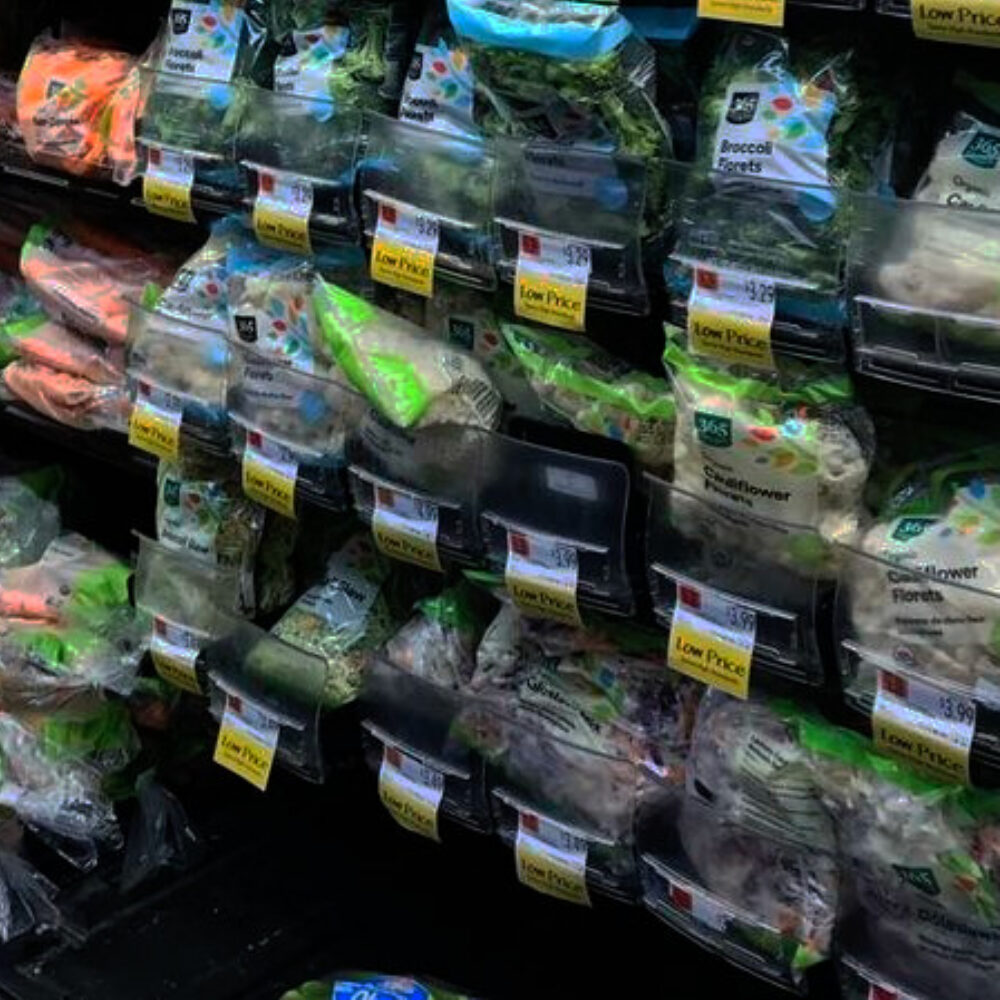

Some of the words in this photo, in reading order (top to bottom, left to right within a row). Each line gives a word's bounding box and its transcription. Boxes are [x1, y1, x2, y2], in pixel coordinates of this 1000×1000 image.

[919, 5, 954, 20] Low
[957, 6, 1000, 26] Price
[720, 139, 774, 155] Broccoli
[718, 156, 763, 174] Florets
[376, 251, 398, 266] Low
[400, 255, 429, 275] Price
[520, 286, 545, 302] Low
[547, 290, 581, 311] Price
[693, 321, 724, 340] Low
[726, 327, 767, 348] Price
[703, 464, 792, 503] Cauliflower
[513, 584, 538, 600] Low
[540, 590, 574, 611] Price
[676, 636, 704, 658] Low
[707, 645, 746, 678] Price
[221, 733, 241, 753] Low
[242, 744, 268, 770] Price
[881, 727, 916, 751] Low
[918, 739, 965, 773] Price
